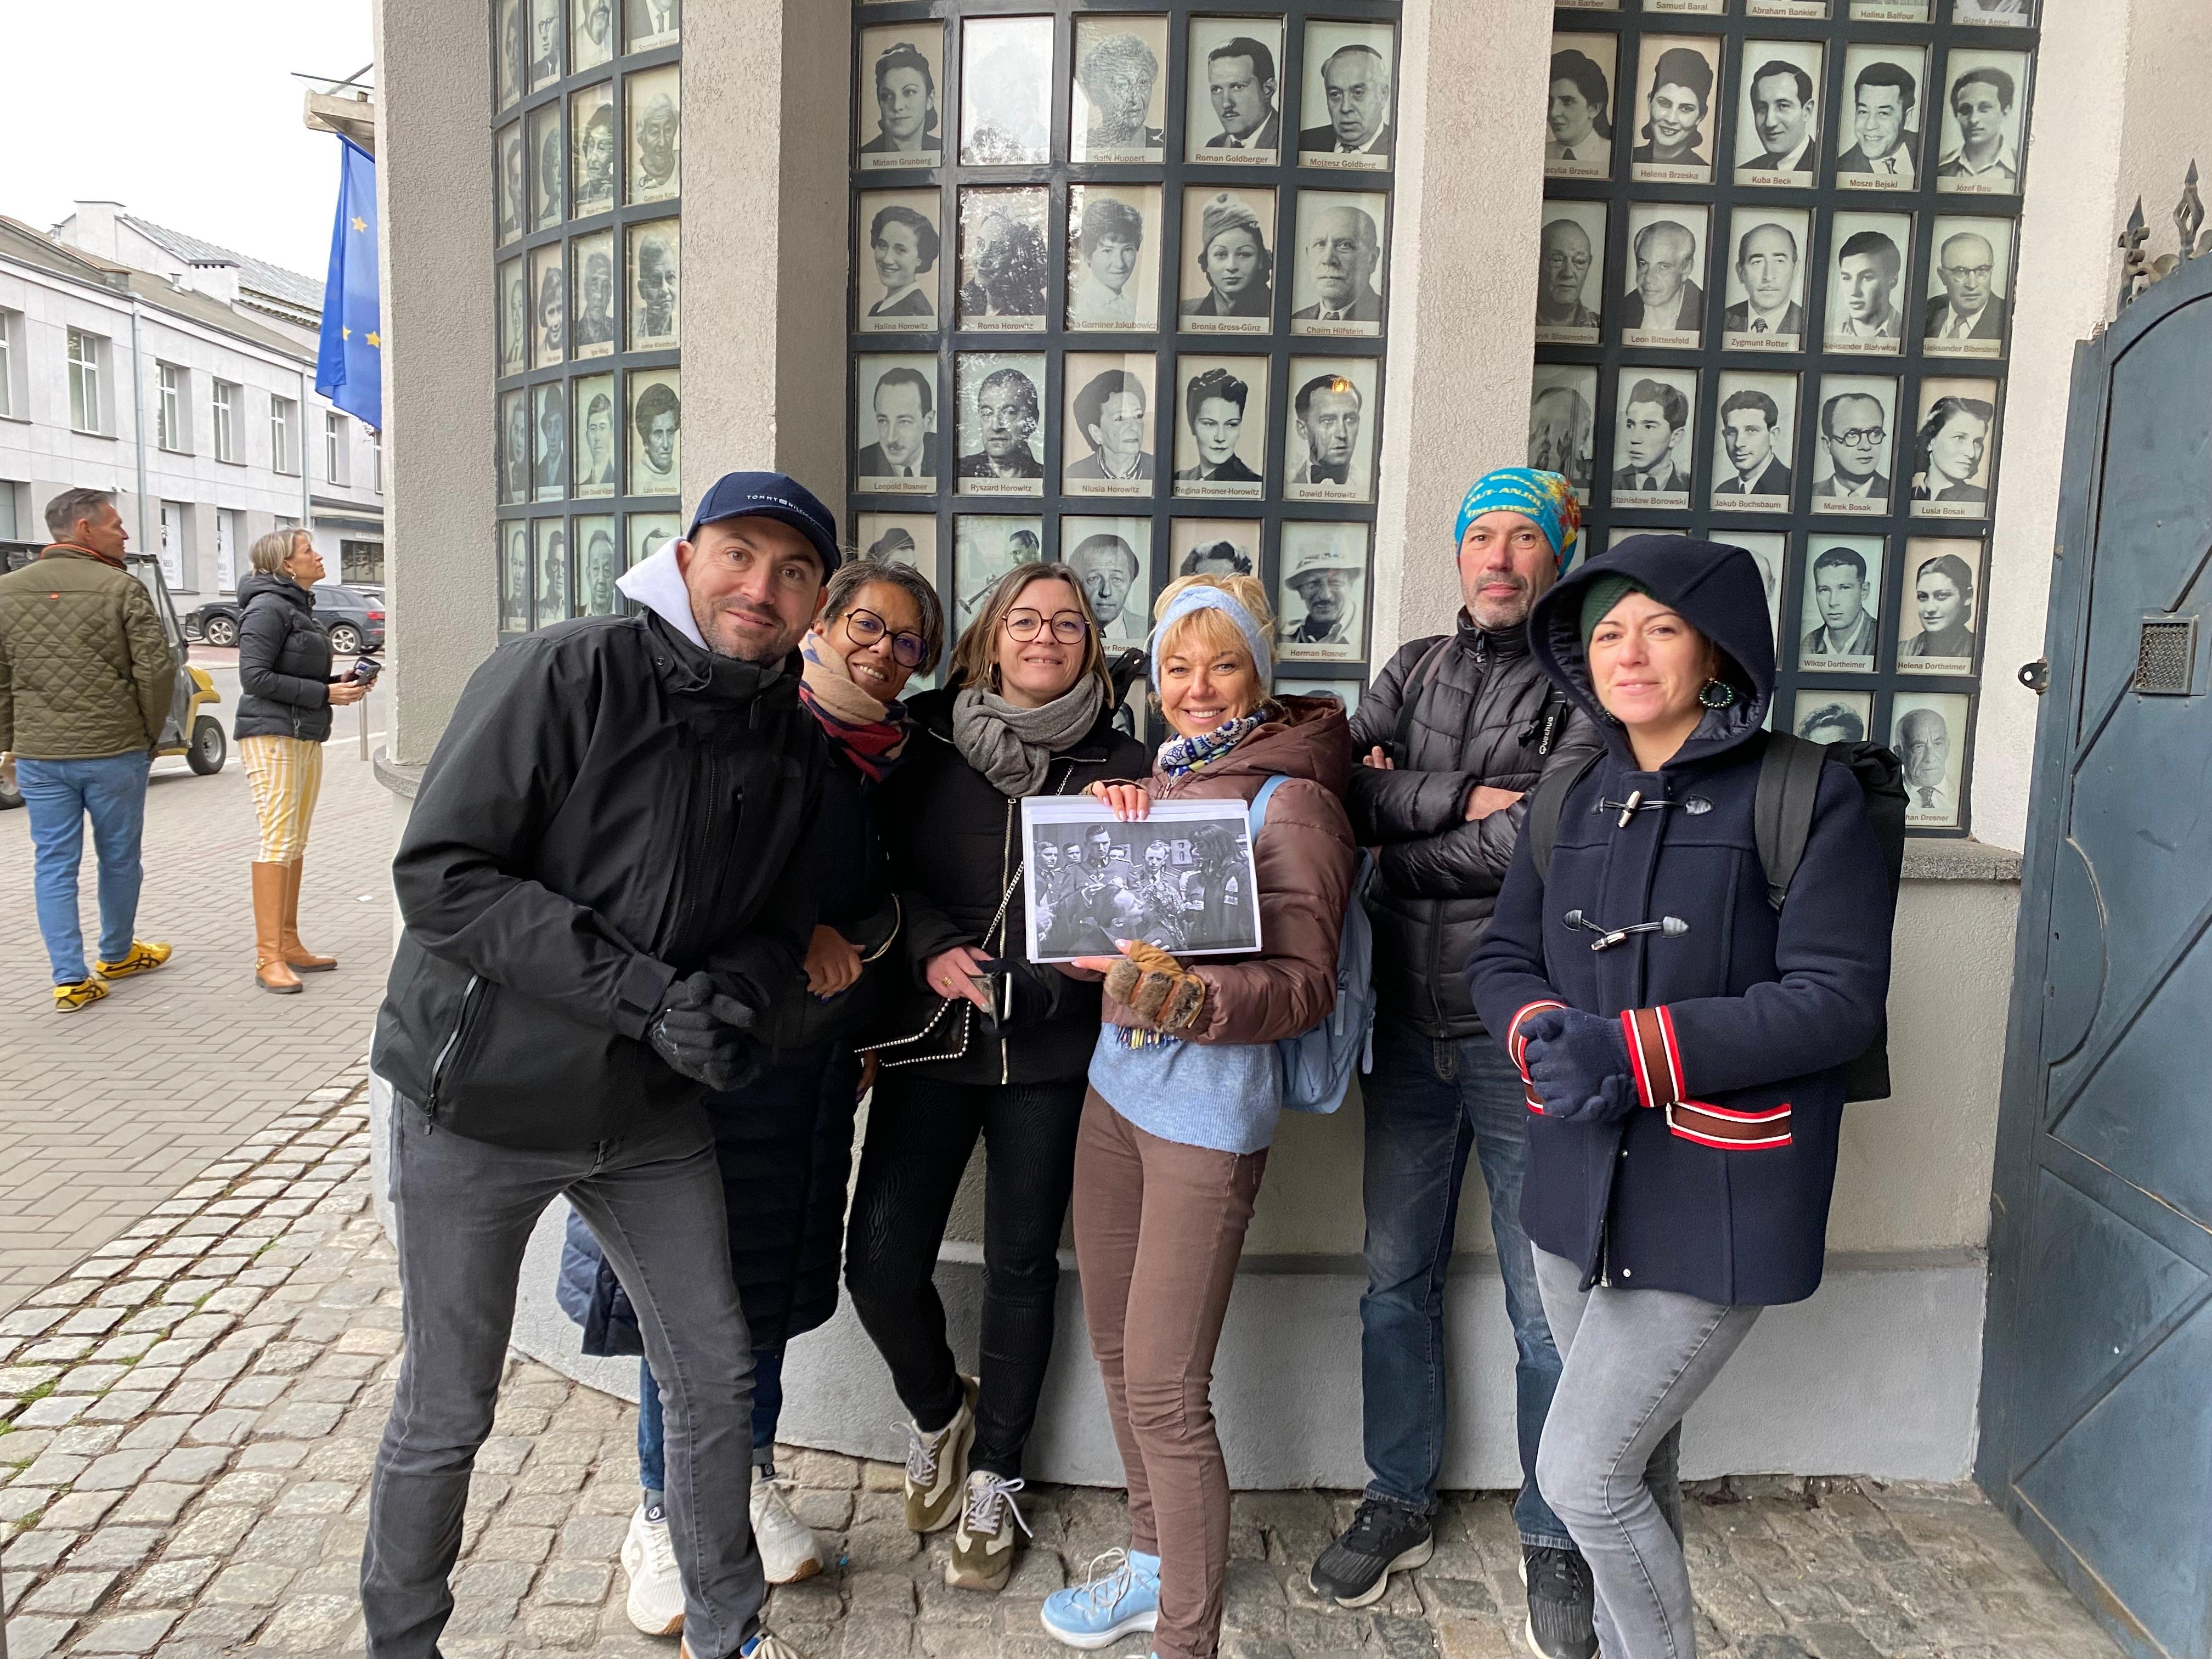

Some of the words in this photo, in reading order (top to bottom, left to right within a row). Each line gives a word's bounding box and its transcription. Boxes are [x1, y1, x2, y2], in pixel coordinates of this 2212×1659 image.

[1226, 155, 1268, 164] Goldberger
[1310, 159, 1340, 167] Mojżesz
[1342, 160, 1376, 169] Goldberg
[1669, 171, 1698, 179] Brzeska
[1115, 321, 1156, 329] Jakubowicz
[1551, 333, 1594, 341] Blasenstein
[1731, 338, 1763, 347] Zygmunt
[1538, 716, 1554, 754] Quechua
